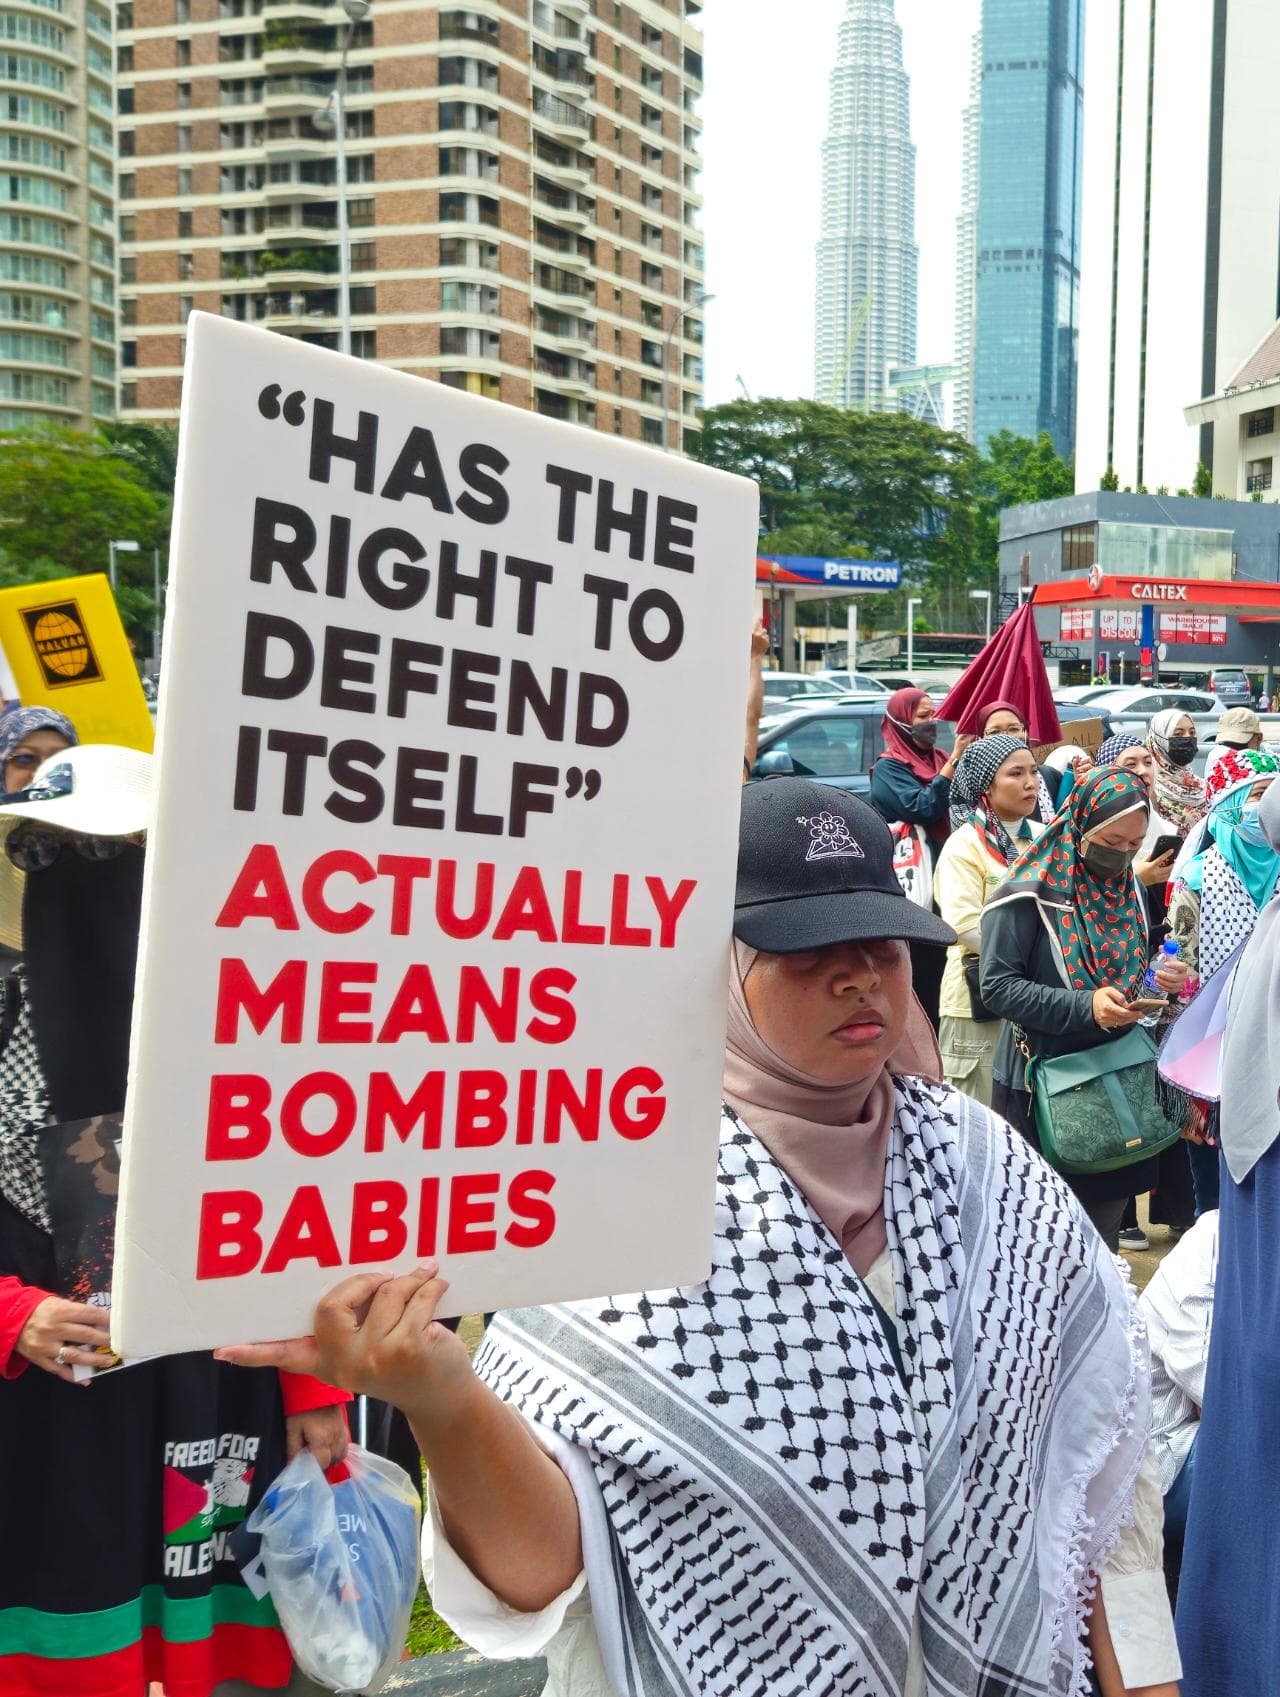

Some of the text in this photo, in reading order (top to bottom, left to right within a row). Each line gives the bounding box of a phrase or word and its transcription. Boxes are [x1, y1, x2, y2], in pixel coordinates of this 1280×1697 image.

[258, 384, 698, 574] “HAS THE
[250, 497, 685, 662] RIGHT TO
[824, 562, 898, 583] PETRON
[1131, 584, 1187, 600] CALTEX
[242, 611, 629, 747] DEFEND
[234, 726, 602, 838] ITSELF”
[216, 843, 697, 949] ACTUALLY
[215, 957, 578, 1045] MEANS
[204, 1066, 668, 1162] BOMBING
[196, 1168, 557, 1281] BABIES
[164, 1437, 216, 1468] FREED
